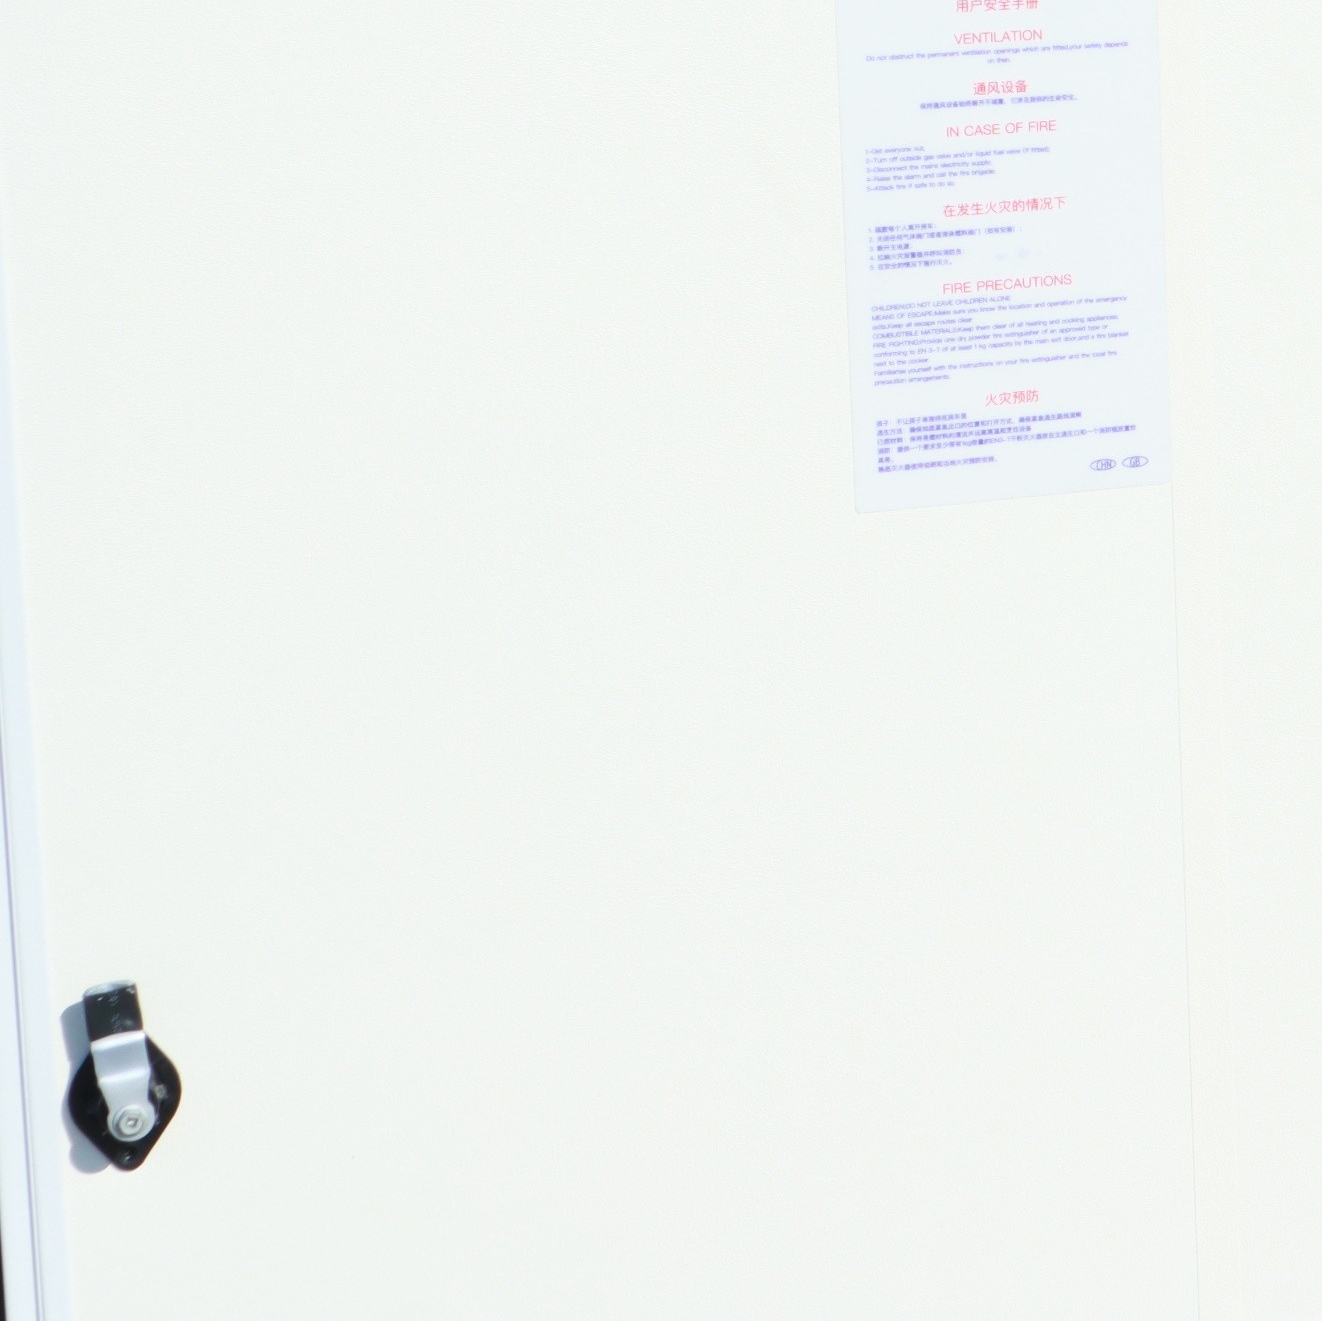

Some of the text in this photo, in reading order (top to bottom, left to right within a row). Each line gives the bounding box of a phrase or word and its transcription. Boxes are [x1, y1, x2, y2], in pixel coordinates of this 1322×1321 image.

[954, 29, 1043, 45] VENTILATION
[973, 80, 1028, 96] 通风设备
[946, 120, 1057, 139] IN CASE OF FIRE
[943, 196, 1067, 218] 在发生火灾的情况下
[942, 274, 1073, 295] FIRE PRECAUTIONS
[985, 389, 1040, 406] 火灾预防
